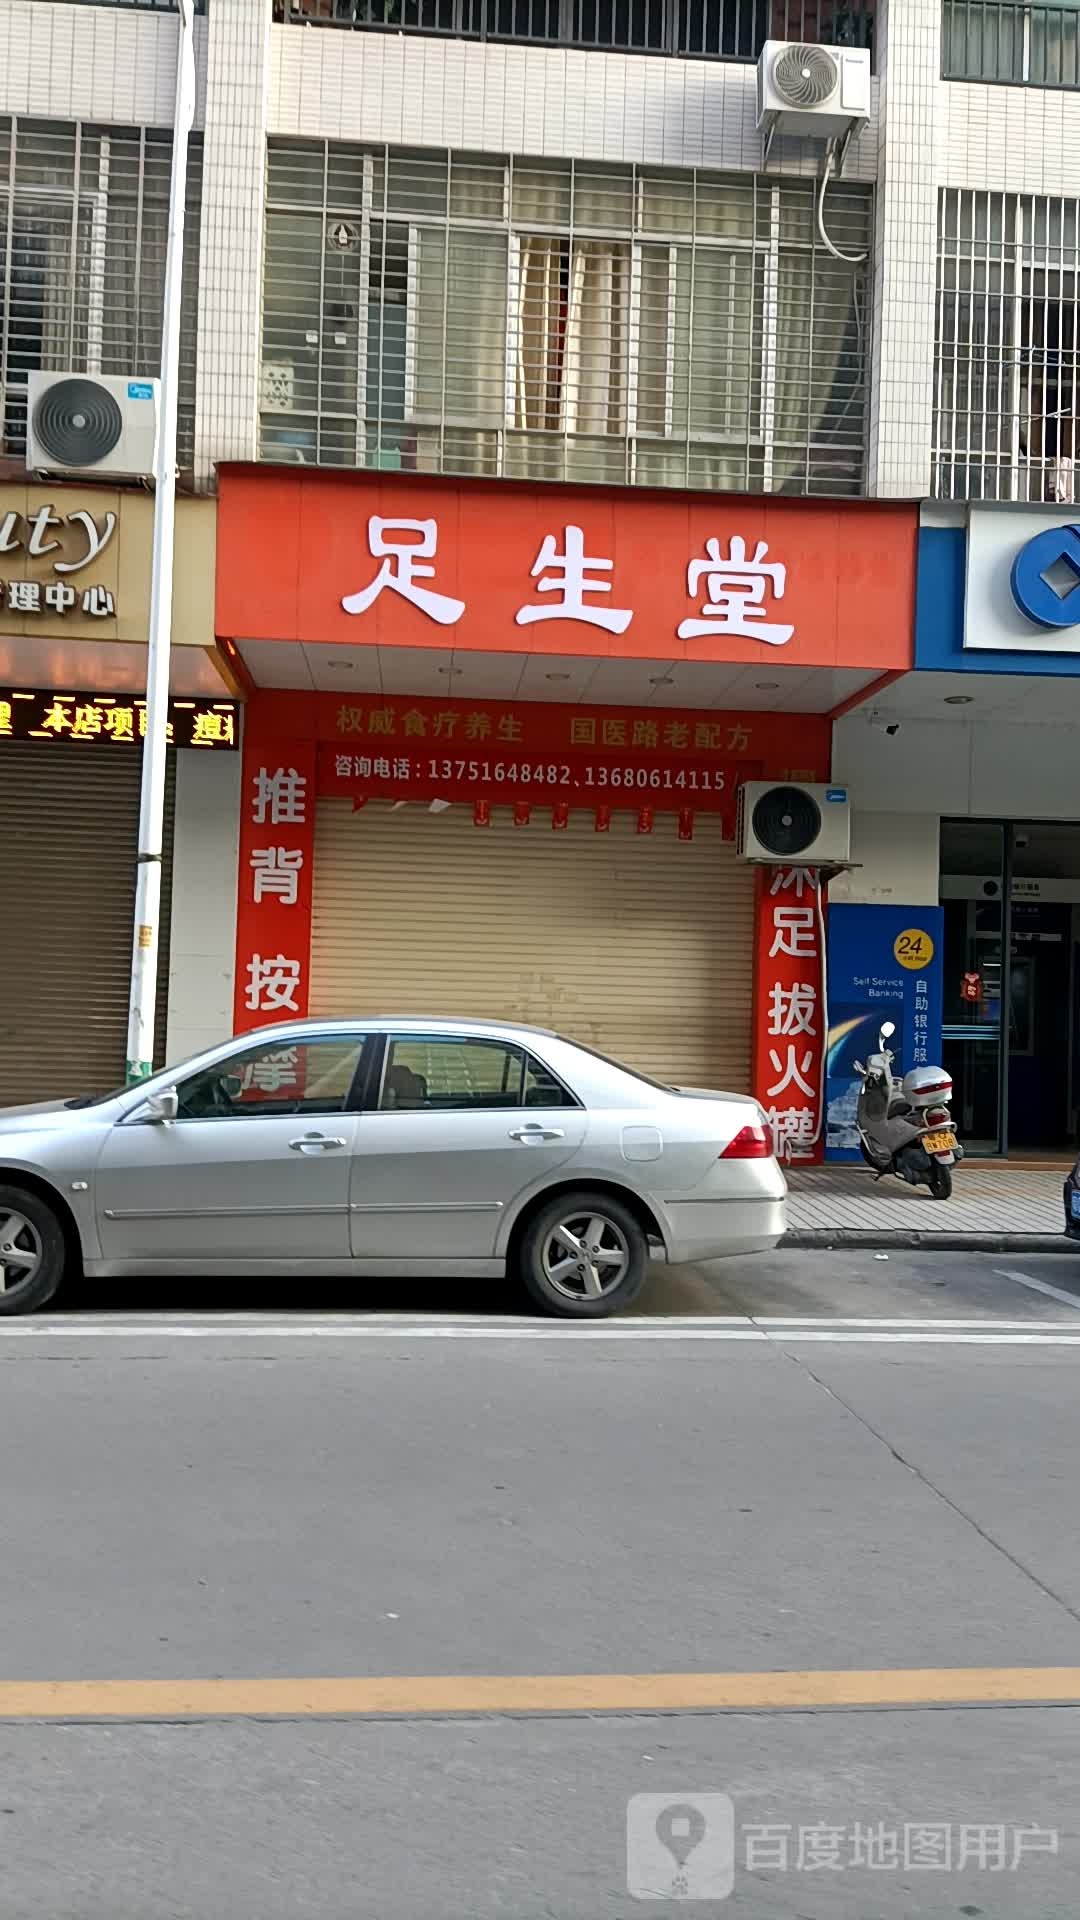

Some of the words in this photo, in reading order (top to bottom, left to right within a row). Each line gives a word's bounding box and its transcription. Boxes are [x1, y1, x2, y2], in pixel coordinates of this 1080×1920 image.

[0, 580, 115, 617] 理中心
[341, 515, 795, 646] 足生堂
[336, 704, 524, 743] 权威食疗养生
[571, 717, 752, 751] 国医路老配方
[898, 936, 923, 954] 24
[868, 989, 904, 999] Banking
